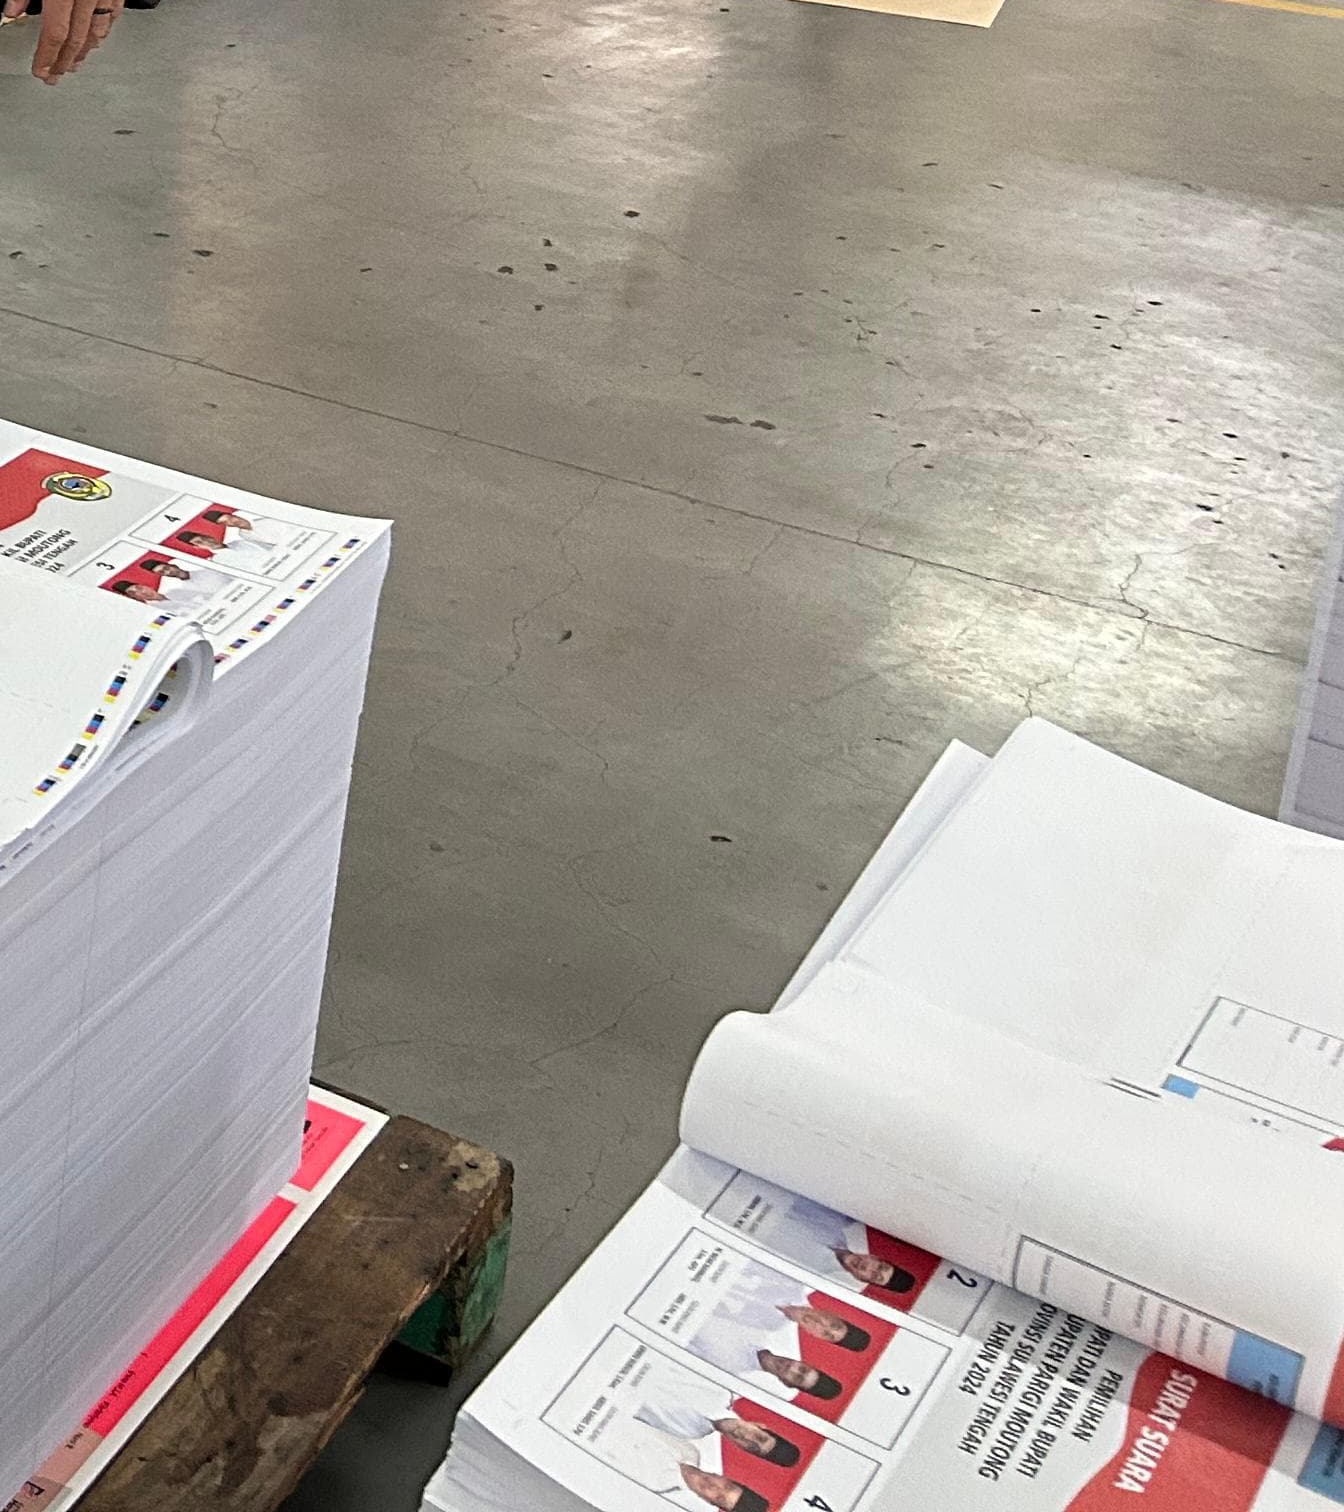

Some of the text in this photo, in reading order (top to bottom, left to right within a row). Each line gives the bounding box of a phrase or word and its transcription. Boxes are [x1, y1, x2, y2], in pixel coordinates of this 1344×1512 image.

[164, 514, 181, 523] 4
[14, 529, 48, 549] BUPATI
[24, 528, 72, 559] MOUTONG
[96, 561, 116, 571] 3
[946, 1268, 978, 1289] 2
[957, 1319, 1015, 1396] TAHUN 2024
[879, 1377, 912, 1396] 3
[957, 1301, 1059, 1456] OVINSI SULAWESI TENGAH
[978, 1311, 1087, 1482] UPATEN PARIGI MOUTONG
[1015, 1325, 1114, 1480] PATI DAN WAKIL BUPATI
[1072, 1367, 1124, 1443] PEMILIHAN
[1114, 1367, 1199, 1494] SURAT SUARA
[803, 1494, 834, 1512] 4
